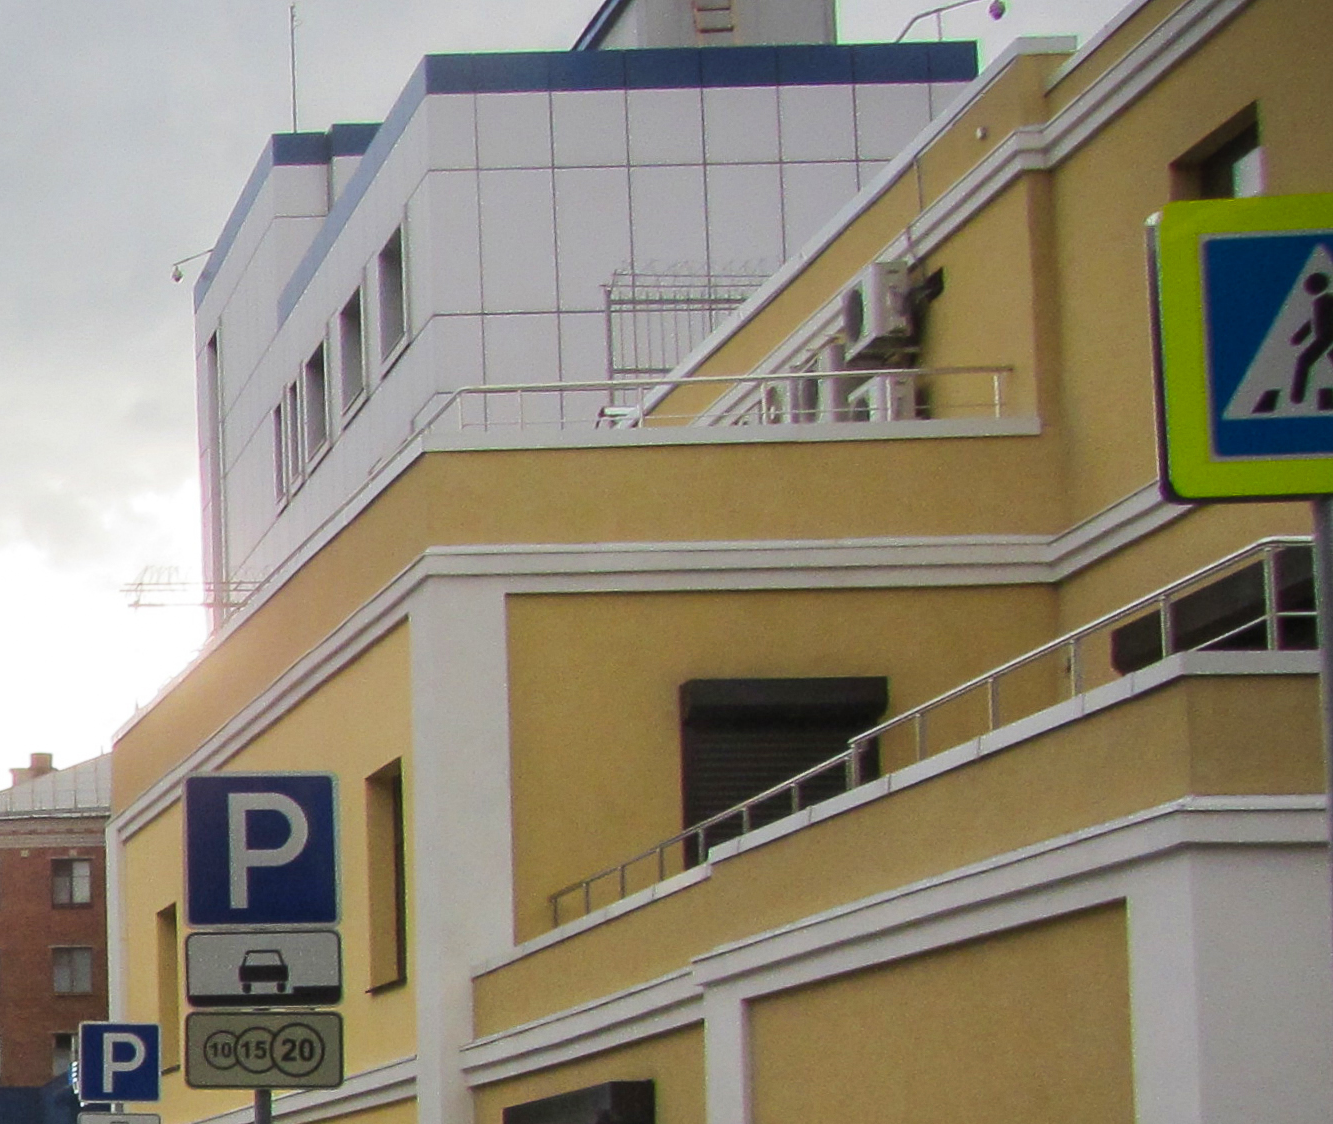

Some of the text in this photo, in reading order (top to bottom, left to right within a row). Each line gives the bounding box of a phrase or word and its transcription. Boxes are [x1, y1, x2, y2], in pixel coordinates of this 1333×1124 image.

[229, 792, 309, 910] P
[102, 1032, 146, 1094] P
[209, 1038, 314, 1062] 10 15 20
